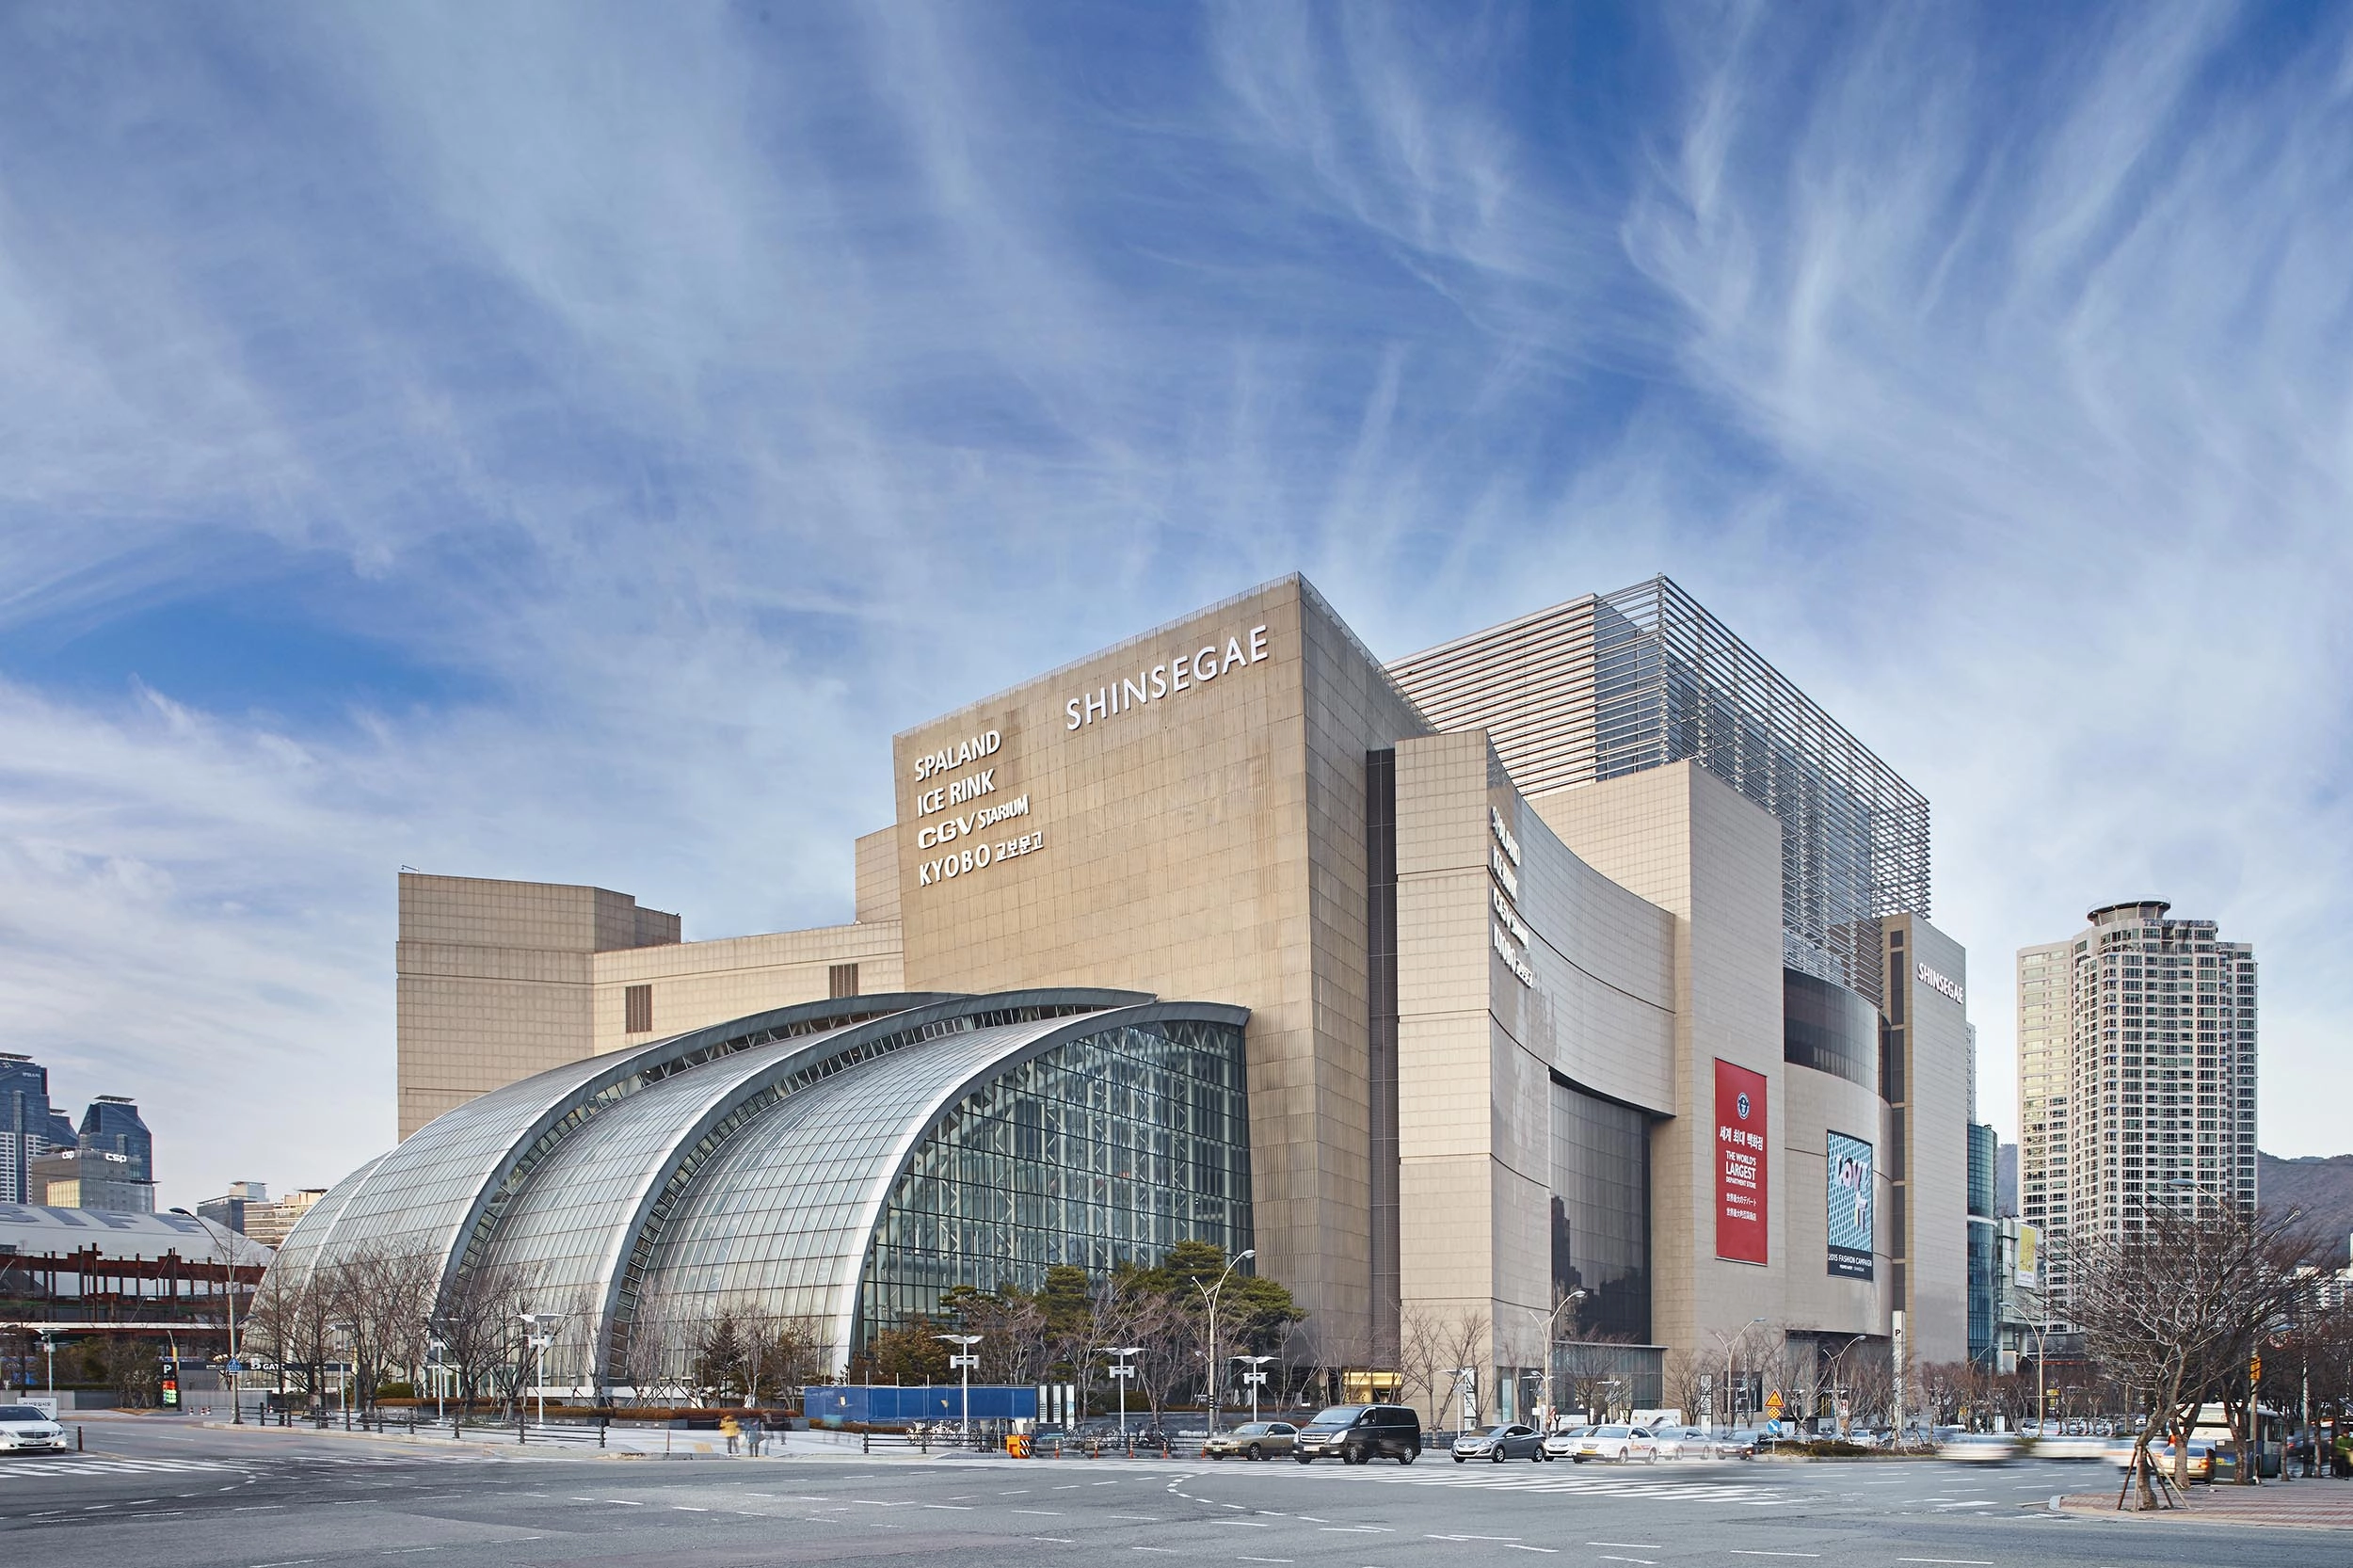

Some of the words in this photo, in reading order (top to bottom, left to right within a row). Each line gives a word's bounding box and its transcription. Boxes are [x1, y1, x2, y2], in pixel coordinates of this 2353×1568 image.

[1066, 625, 1269, 731] SHINSEGAE
[915, 729, 1000, 782] SPALAND
[918, 787, 945, 817] ICE
[950, 768, 996, 805] RINK
[918, 812, 976, 849] CGV
[978, 793, 1029, 829] STARIUM
[919, 843, 991, 887] KYOBO
[995, 830, 1044, 862] 교보문고
[2143, 919, 2177, 927] TRUMP
[2179, 920, 2215, 928] WORLD
[1918, 962, 1963, 1004] SHINSEGAE
[1720, 1126, 1732, 1143] 세계
[1733, 1128, 1745, 1145] 최대
[1747, 1132, 1763, 1151] 백화점
[1725, 1150, 1737, 1161] THE
[1737, 1152, 1756, 1166] WORLD'S
[1725, 1160, 1756, 1180] LARGEST
[1828, 1253, 1838, 1262] 2015
[1838, 1255, 1856, 1264] FASHION
[163, 1364, 172, 1374] P
